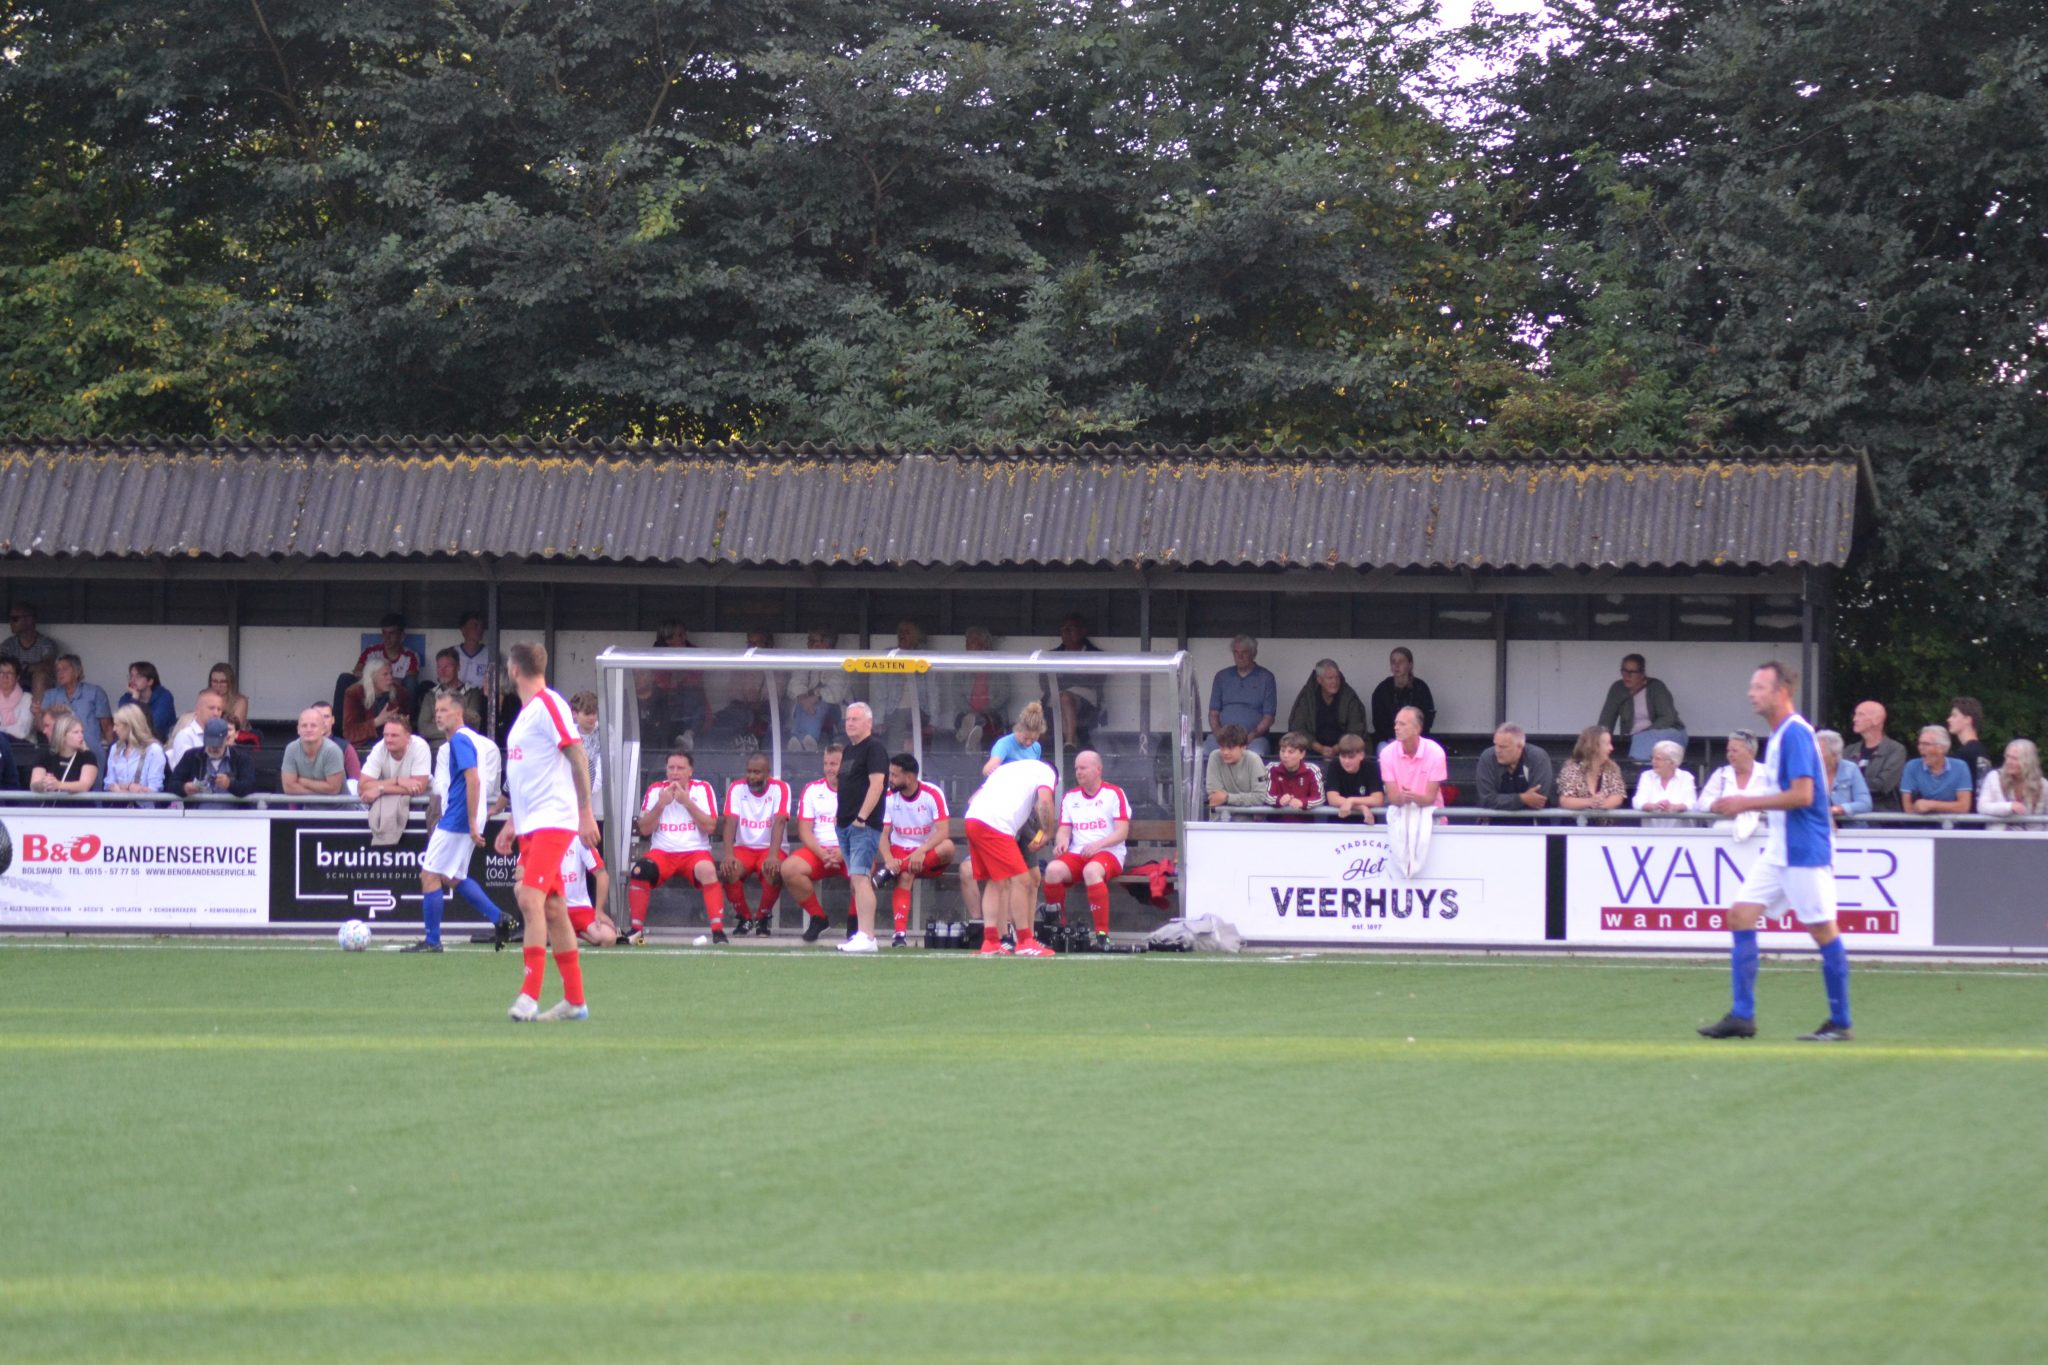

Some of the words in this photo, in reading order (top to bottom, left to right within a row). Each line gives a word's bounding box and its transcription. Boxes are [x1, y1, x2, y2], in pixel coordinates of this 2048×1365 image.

[864, 661, 905, 669] GASTEN
[22, 834, 101, 862] B&O
[103, 846, 257, 864] BANDENSERVICE
[1335, 840, 1393, 855] STADSCAF
[22, 867, 62, 875] BOLSWARD
[69, 867, 82, 875] TEL.
[85, 867, 102, 875] 0515
[109, 867, 118, 875] 57
[120, 867, 129, 875] 77
[131, 867, 140, 875] 55
[146, 868, 256, 877] WWW.BENOBANDENSERVICE.NL
[486, 868, 508, 880] (06)
[1343, 857, 1388, 881] Het
[1602, 845, 1898, 907] WANER
[1271, 887, 1459, 919] VEERHUYS
